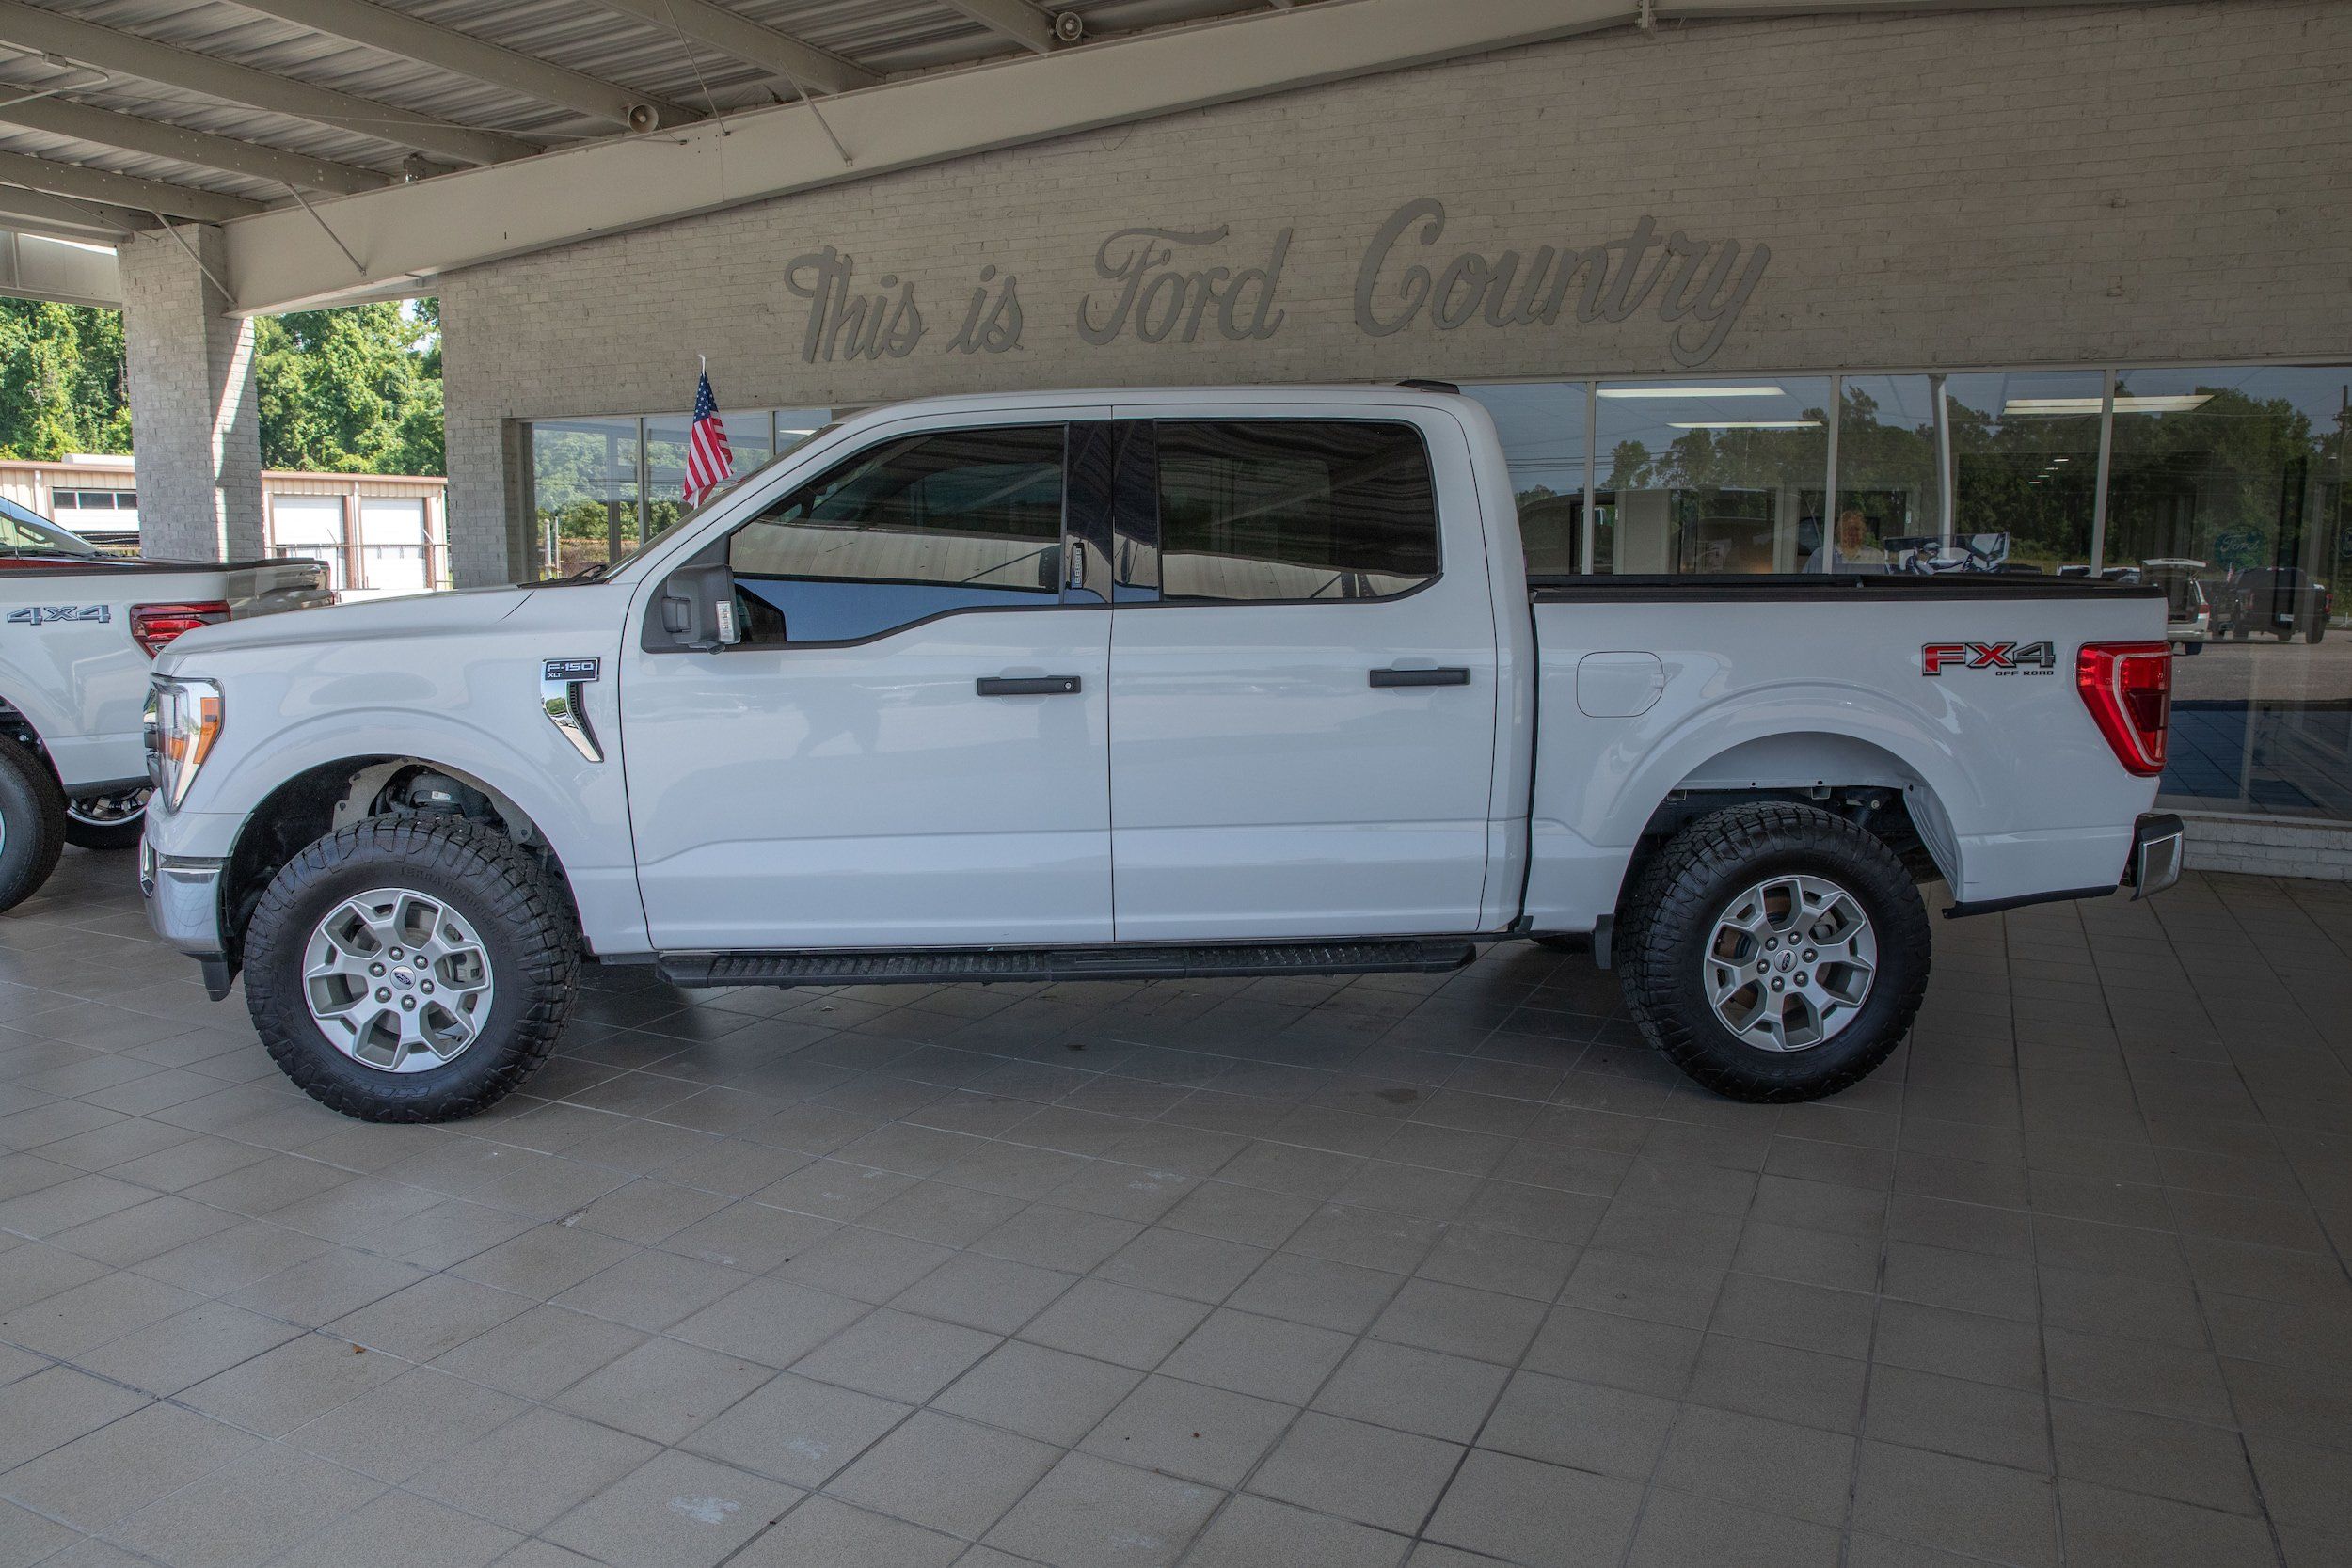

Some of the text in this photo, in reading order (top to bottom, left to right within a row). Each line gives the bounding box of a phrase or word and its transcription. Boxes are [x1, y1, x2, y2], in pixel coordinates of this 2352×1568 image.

[784, 198, 1770, 367] This is Ford Country
[2220, 532, 2260, 553] Ford
[547, 662, 594, 672] F-150
[1921, 641, 2056, 676] FX4
